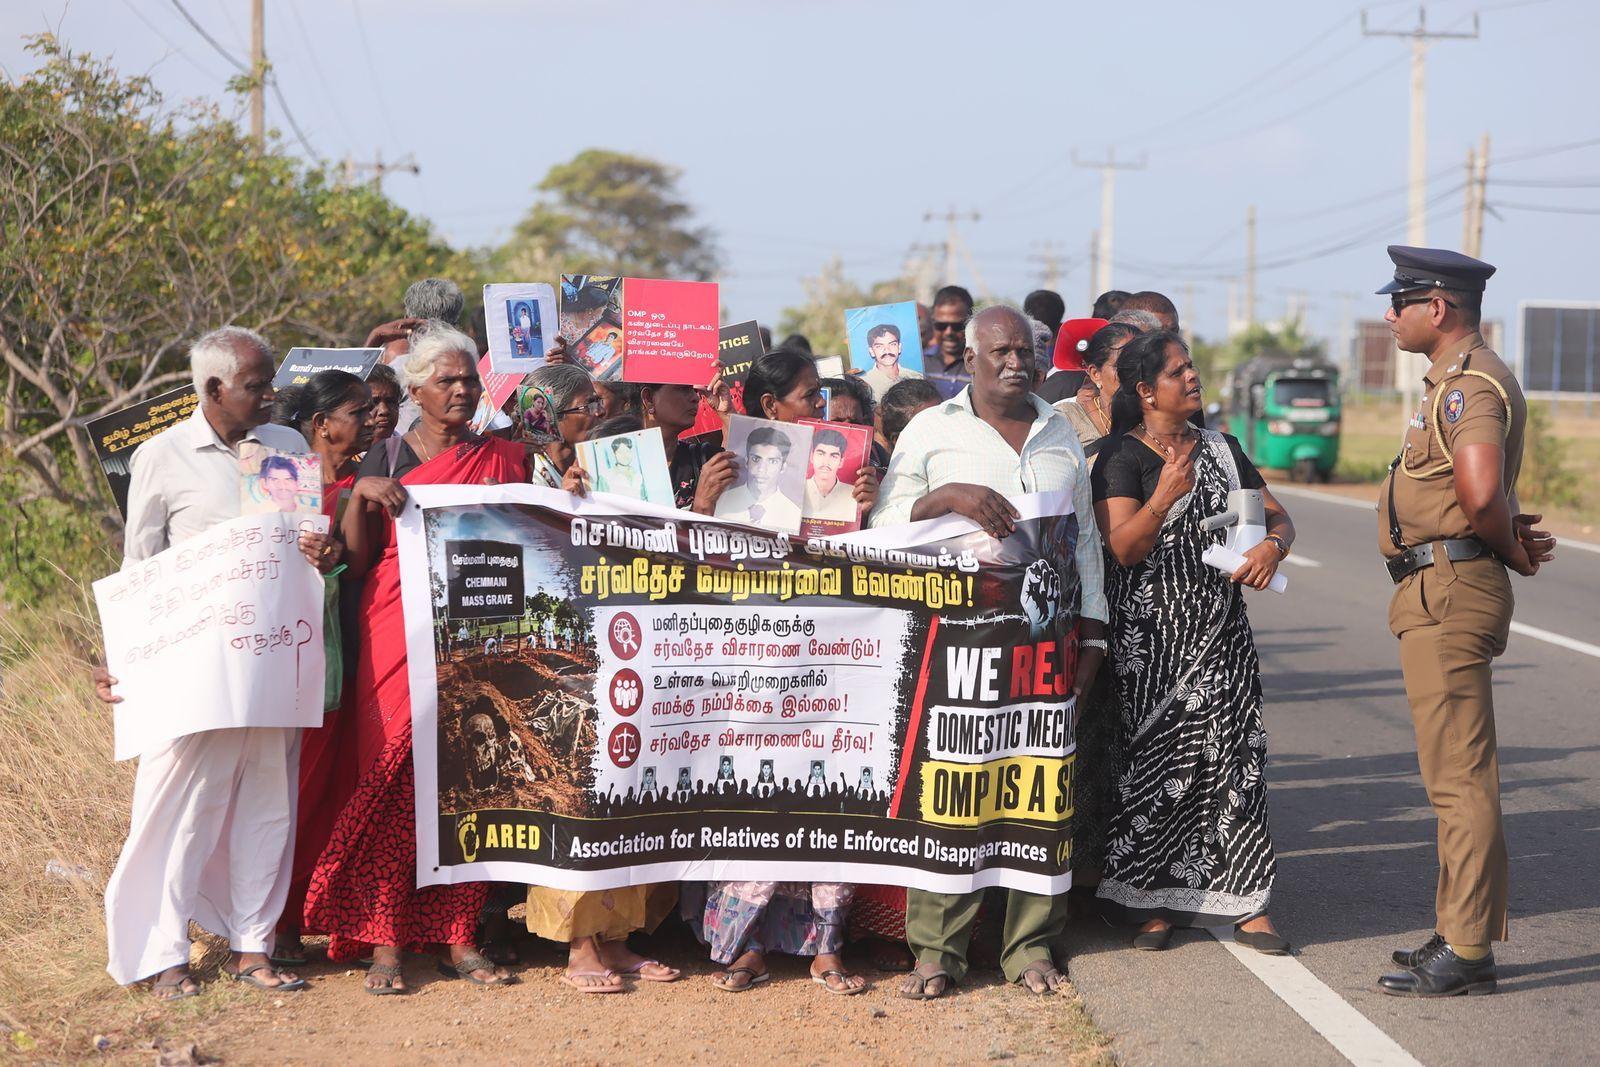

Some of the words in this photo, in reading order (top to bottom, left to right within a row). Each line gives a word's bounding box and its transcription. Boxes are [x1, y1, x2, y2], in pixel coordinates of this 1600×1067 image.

[718, 335, 750, 351] TICE
[722, 360, 753, 377] ILITY
[570, 517, 680, 554] செம்மணி
[688, 524, 794, 562] புதைகுழி
[451, 552, 486, 566] செம்மணி
[487, 556, 519, 568] புதைகுழி
[465, 577, 507, 588] CHEMMANI
[580, 556, 686, 602] சர்வதேச
[696, 561, 841, 602] மேற்பார்வை
[851, 564, 975, 609] வேண்டும்!
[461, 595, 484, 607] MASS
[486, 594, 513, 605] GRAVE
[652, 611, 816, 636] மனிதப்புதைகுழிகளுக்கு
[653, 638, 714, 662] சர்வதேச
[722, 637, 801, 661] விசாரணை
[808, 637, 881, 660] வேண்டும்!
[946, 646, 1002, 702] WE
[1010, 628, 1079, 698] REJ
[653, 670, 705, 690] உள்ளக
[651, 694, 696, 717] எமக்கு
[701, 691, 774, 717] நம்பிக்கை
[780, 693, 848, 719] இல்லை!
[649, 730, 712, 756] சர்வதேச
[718, 727, 826, 751] விசாரணையே
[831, 727, 875, 754] தீர்வு!
[937, 711, 1022, 755] DOMESTIC
[1026, 703, 1077, 750] MECHA
[933, 767, 990, 818] OMP
[994, 763, 1021, 812] IS
[1027, 765, 1046, 813] A
[485, 823, 541, 850] ARED
[569, 832, 665, 859] Association
[670, 828, 695, 849] for
[700, 826, 780, 849] Relatives
[785, 828, 804, 849] of
[809, 828, 838, 849] the
[843, 828, 920, 856] Enforced
[924, 836, 1048, 868] Disappearances
